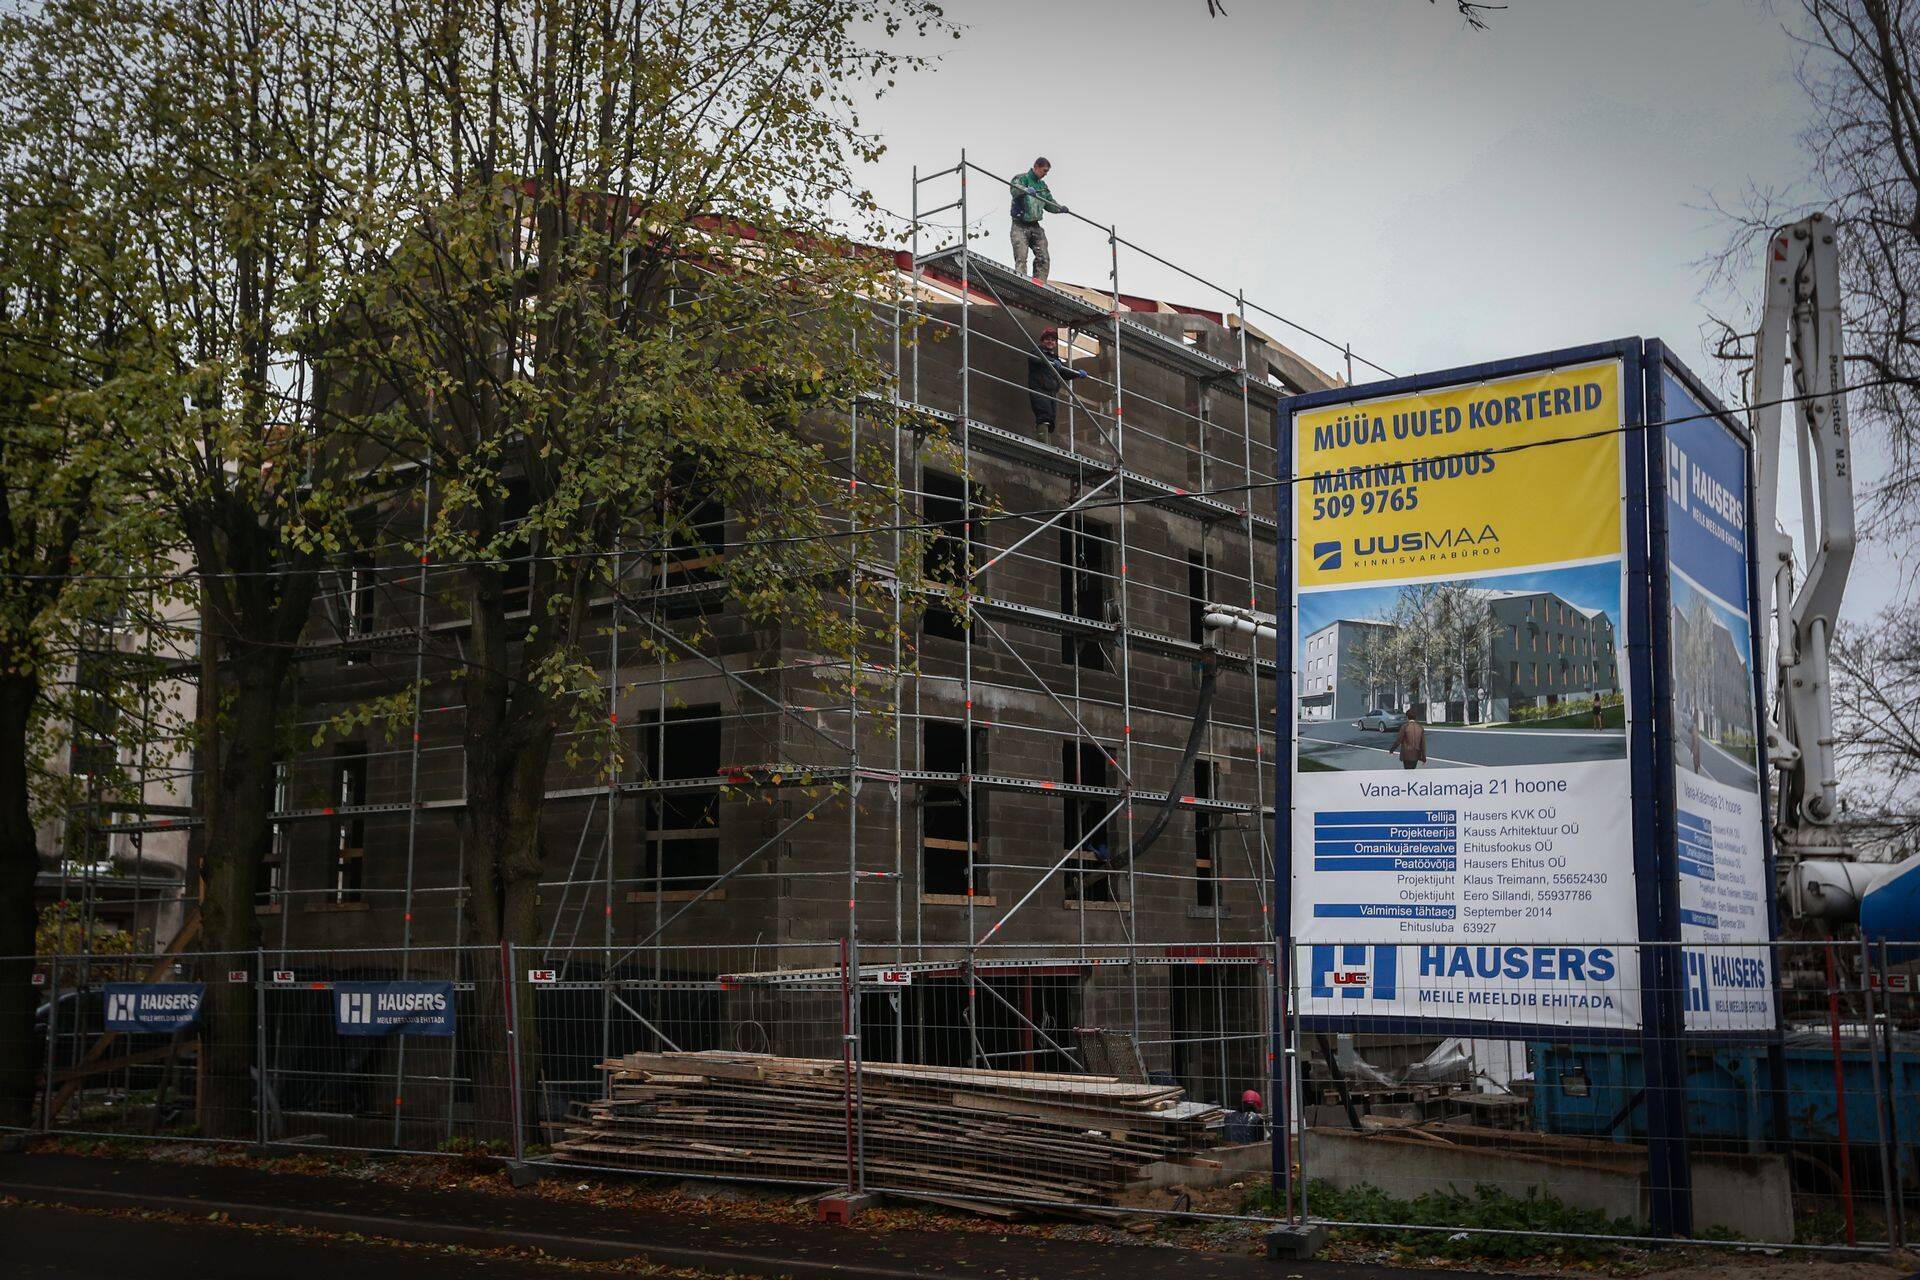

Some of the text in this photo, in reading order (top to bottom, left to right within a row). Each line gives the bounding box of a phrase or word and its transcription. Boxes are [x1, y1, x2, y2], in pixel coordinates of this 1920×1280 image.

[1314, 383, 1602, 451] MÜÜA UUED KORTERID
[1313, 448, 1495, 494] MARINA HODUS
[1313, 486, 1418, 521] 509 9765
[1692, 462, 1743, 531] HAUSERS
[1354, 524, 1499, 556] UUSMAA
[1354, 547, 1501, 568] KINNISVARABÜROO
[1360, 779, 1567, 798] Vana-Kalamaja 21 hoone
[1426, 811, 1455, 824] Tellija
[1464, 807, 1556, 821] Hausers KVK OÜ
[1390, 827, 1455, 840] Projekteerija
[1464, 822, 1579, 837] Kauss Arhitektuur OÜ
[1354, 843, 1455, 856] Omanikujärelevalve
[1464, 839, 1553, 853] Ehitusfookus OÜ
[1394, 858, 1455, 871] Peatöövõtja
[1464, 855, 1566, 869] Hausers Ehitus OÜ
[1397, 874, 1455, 887] Projektijuht
[1464, 873, 1608, 886] Klaus Treimann, 55652430
[1400, 890, 1455, 902] Objektijuht
[1464, 890, 1592, 902] Eero Sillandi, 55937786
[1360, 905, 1455, 919] Valmimise tähtaeg
[1464, 906, 1552, 919] September 2014
[1400, 922, 1454, 933] Ehitusluba
[1463, 923, 1496, 933] 63927
[1420, 945, 1615, 982] HAUSERS
[1711, 955, 1765, 989] HAUSERS
[141, 994, 199, 1010] HAUSERS
[378, 993, 446, 1011] HAUSERS
[1419, 990, 1614, 1009] MEILE MEELDIB EHITADA
